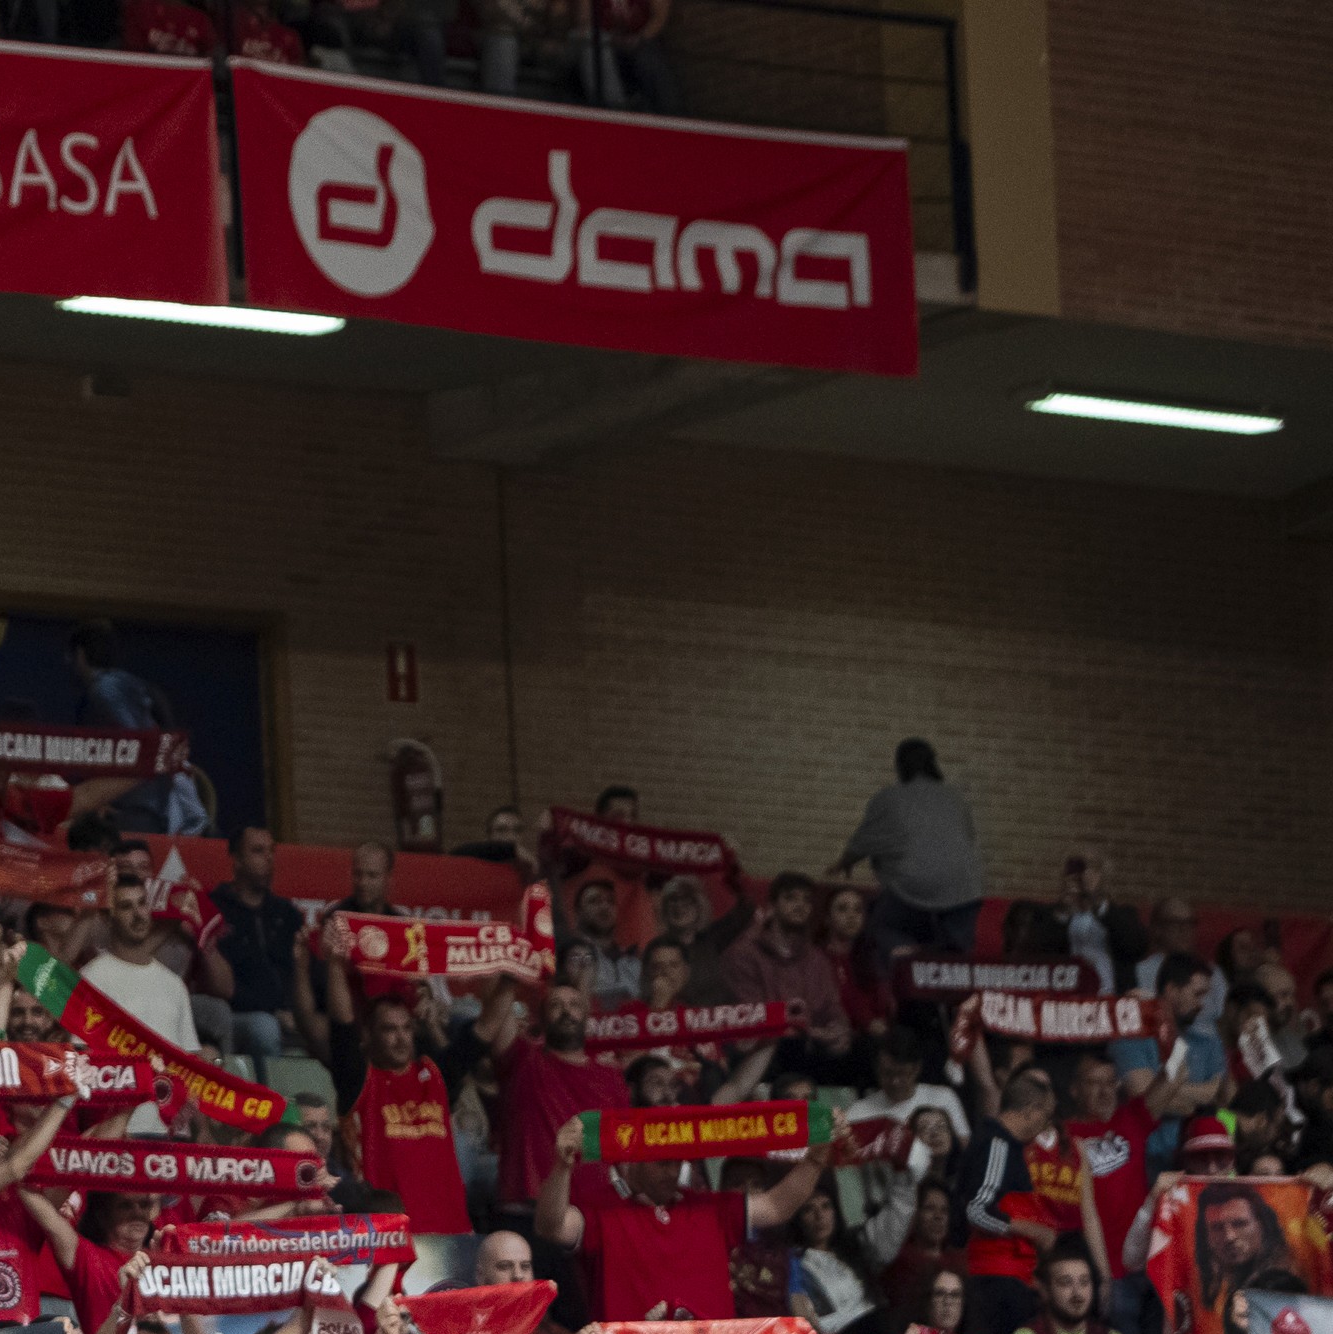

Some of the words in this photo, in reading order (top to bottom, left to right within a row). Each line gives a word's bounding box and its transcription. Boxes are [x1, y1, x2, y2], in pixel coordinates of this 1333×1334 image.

[471, 149, 873, 311] dama
[44, 734, 111, 763] MURCIA
[50, 1150, 134, 1177] VAMOS
[144, 1154, 178, 1181] CB
[187, 1155, 275, 1184] MURCIA
[140, 1265, 209, 1299] UCAM
[213, 1261, 304, 1299] MURCIA
